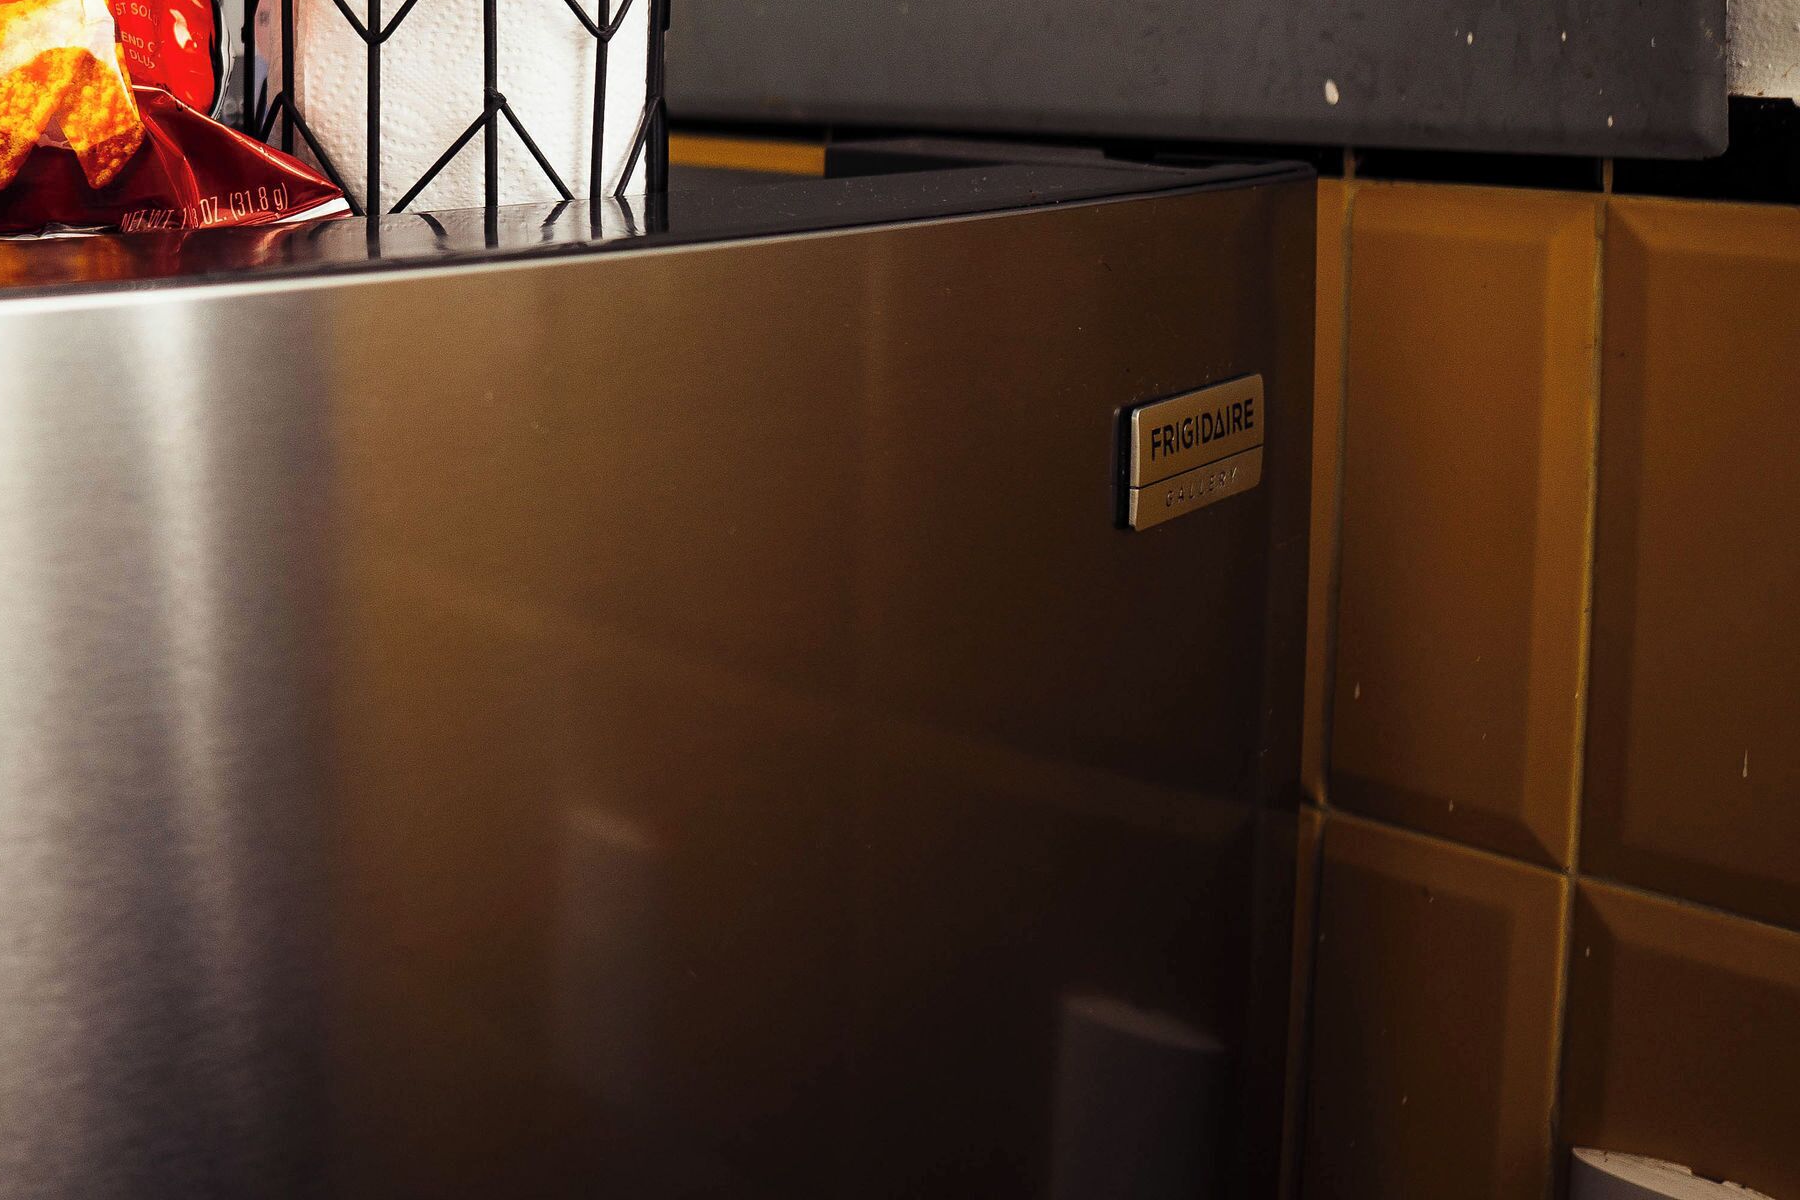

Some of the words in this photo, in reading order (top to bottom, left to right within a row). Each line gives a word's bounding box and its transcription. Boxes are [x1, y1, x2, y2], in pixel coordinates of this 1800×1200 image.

[115, 2, 126, 16] ST
[120, 209, 147, 232] NET
[200, 196, 227, 224] OZ.
[230, 187, 269, 221] (31.8
[275, 182, 289, 211] g)
[1151, 399, 1254, 461] FRIGIDAIRE
[1166, 467, 1238, 507] GALLERY
